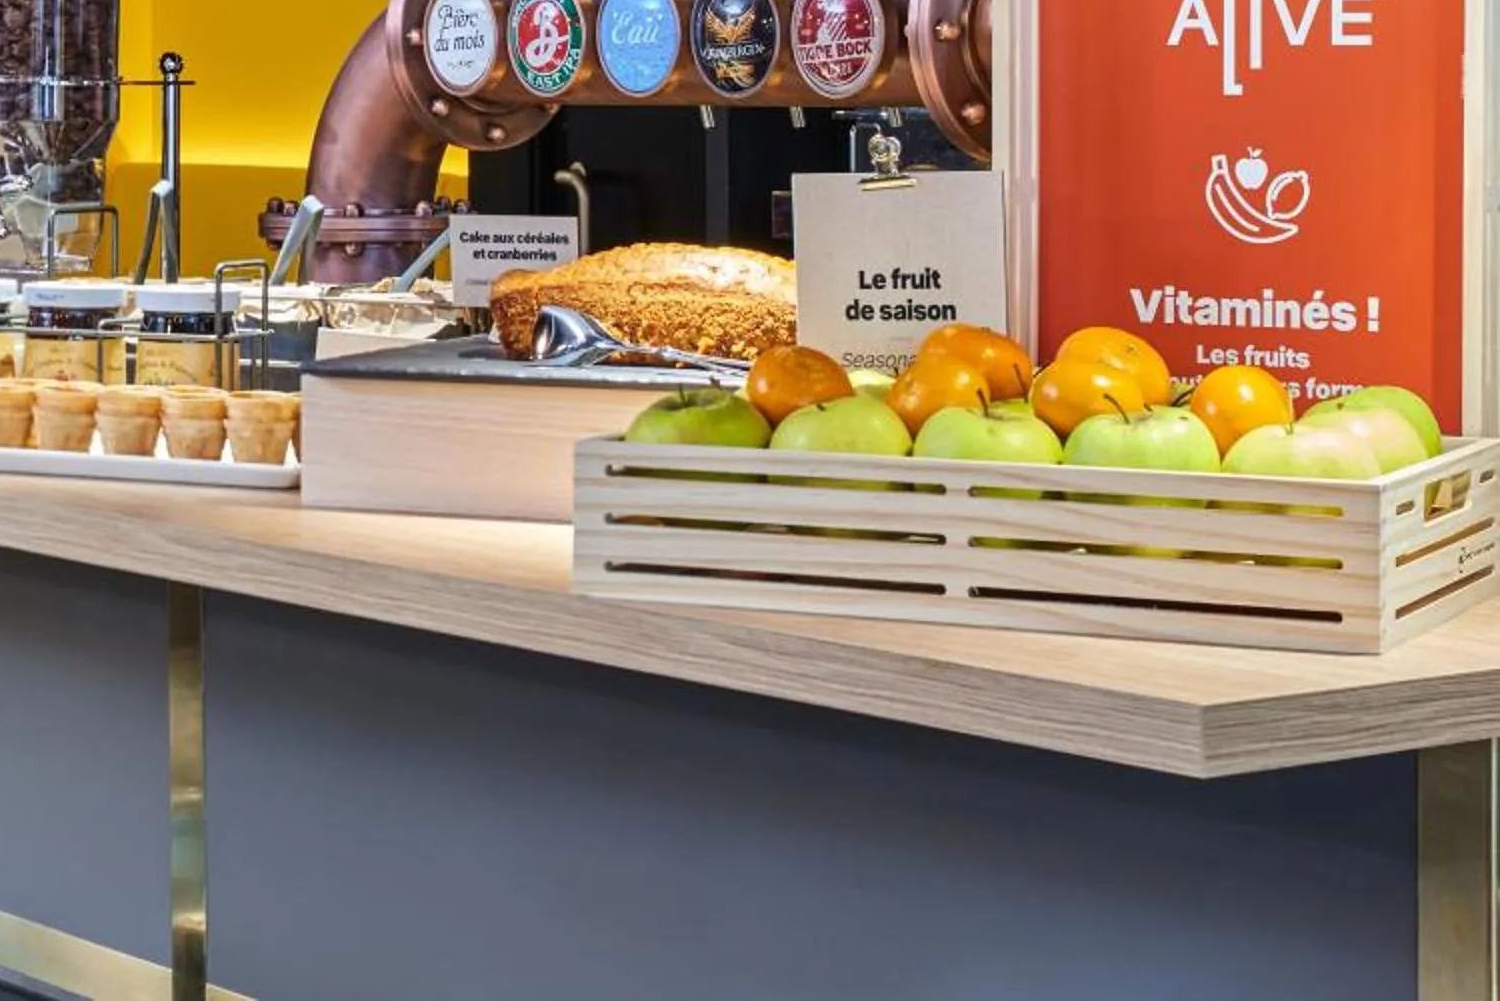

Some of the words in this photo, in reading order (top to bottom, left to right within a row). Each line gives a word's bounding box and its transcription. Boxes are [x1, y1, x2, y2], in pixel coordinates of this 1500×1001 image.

[453, 31, 485, 51] mois
[835, 39, 871, 59] BOCK
[527, 71, 561, 90] EAST
[459, 230, 491, 244] Cake
[492, 234, 514, 244] aux
[516, 231, 570, 246] céréales
[473, 248, 485, 259] et
[487, 248, 558, 262] cranberries
[858, 270, 887, 290] Le
[891, 267, 942, 290] fruit
[845, 298, 875, 321] de
[879, 298, 957, 321] saison
[1129, 285, 1358, 332] Vitaminés
[1196, 345, 1239, 366] Les
[1243, 344, 1311, 369] fruits
